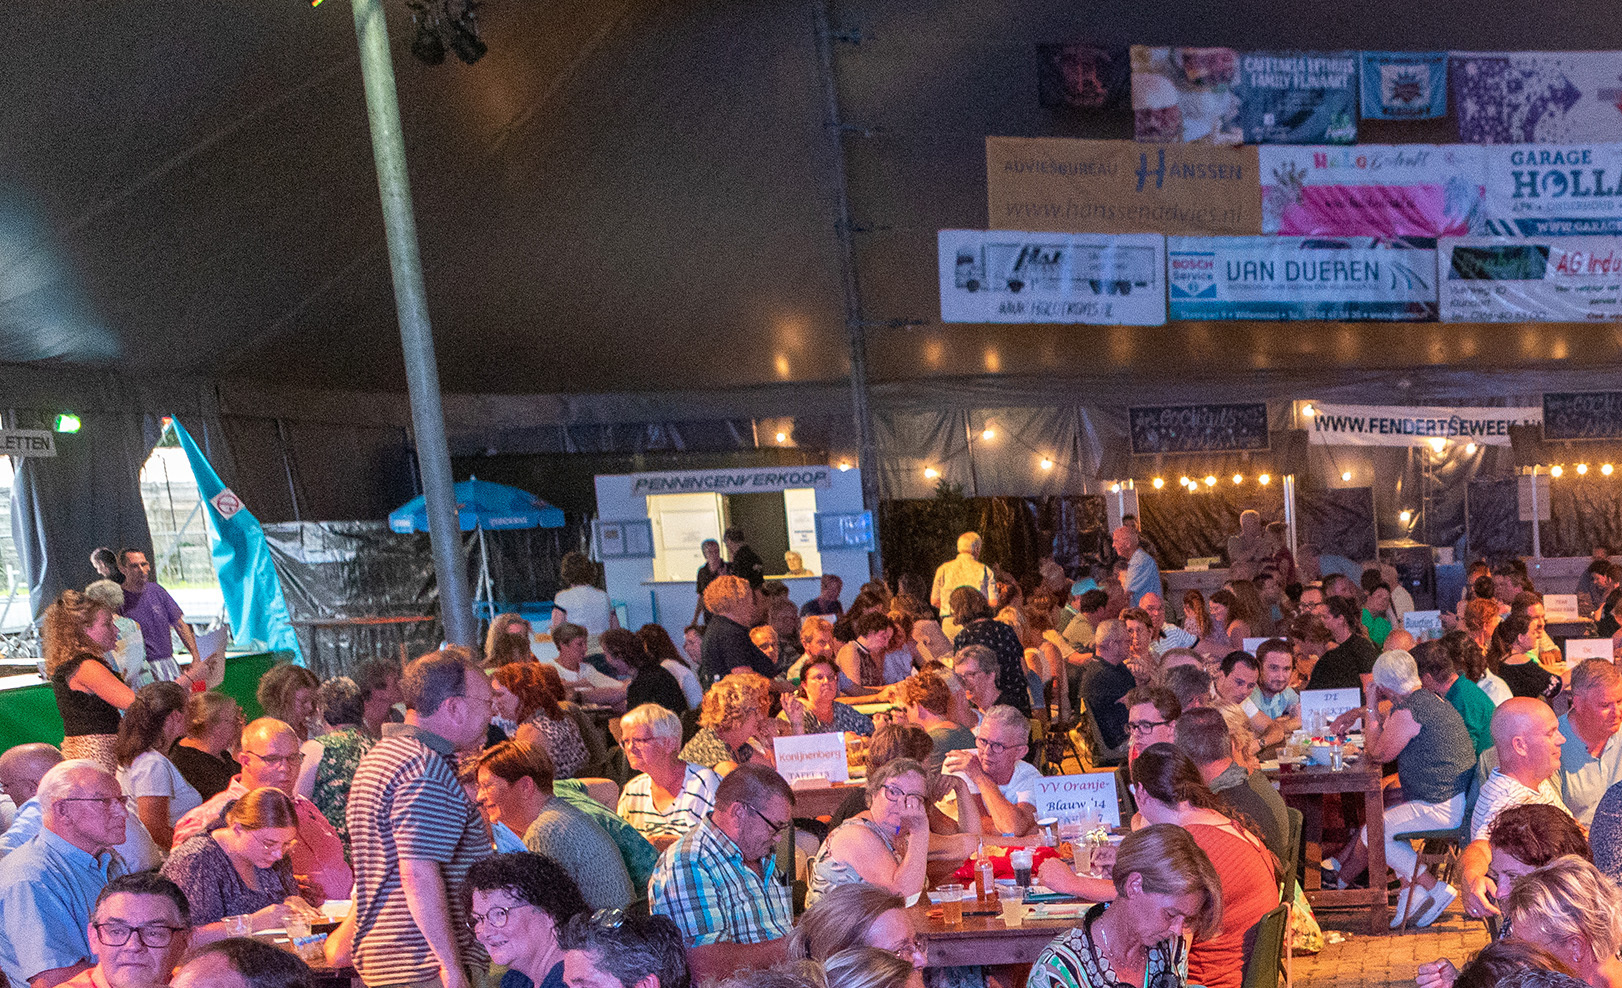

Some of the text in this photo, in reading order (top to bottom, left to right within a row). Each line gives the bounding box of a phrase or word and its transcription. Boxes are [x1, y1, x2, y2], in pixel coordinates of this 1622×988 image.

[1251, 73, 1291, 89] FAMILY
[1511, 149, 1592, 166] GARAGE
[1004, 149, 1242, 192] ADVIESBUREAU HANSSEN
[1172, 259, 1214, 270] BOSCH
[1226, 260, 1380, 282] VAN DUEREN
[1556, 251, 1583, 277] AG
[1173, 270, 1214, 281] Service
[1313, 415, 1542, 437] WWW.FENDERTSEWEEK
[0, 436, 50, 451] ETTEN
[779, 750, 842, 763] Konijnenberg
[1038, 779, 1110, 794] VV Oranje-
[1046, 799, 1087, 812] Blauw
